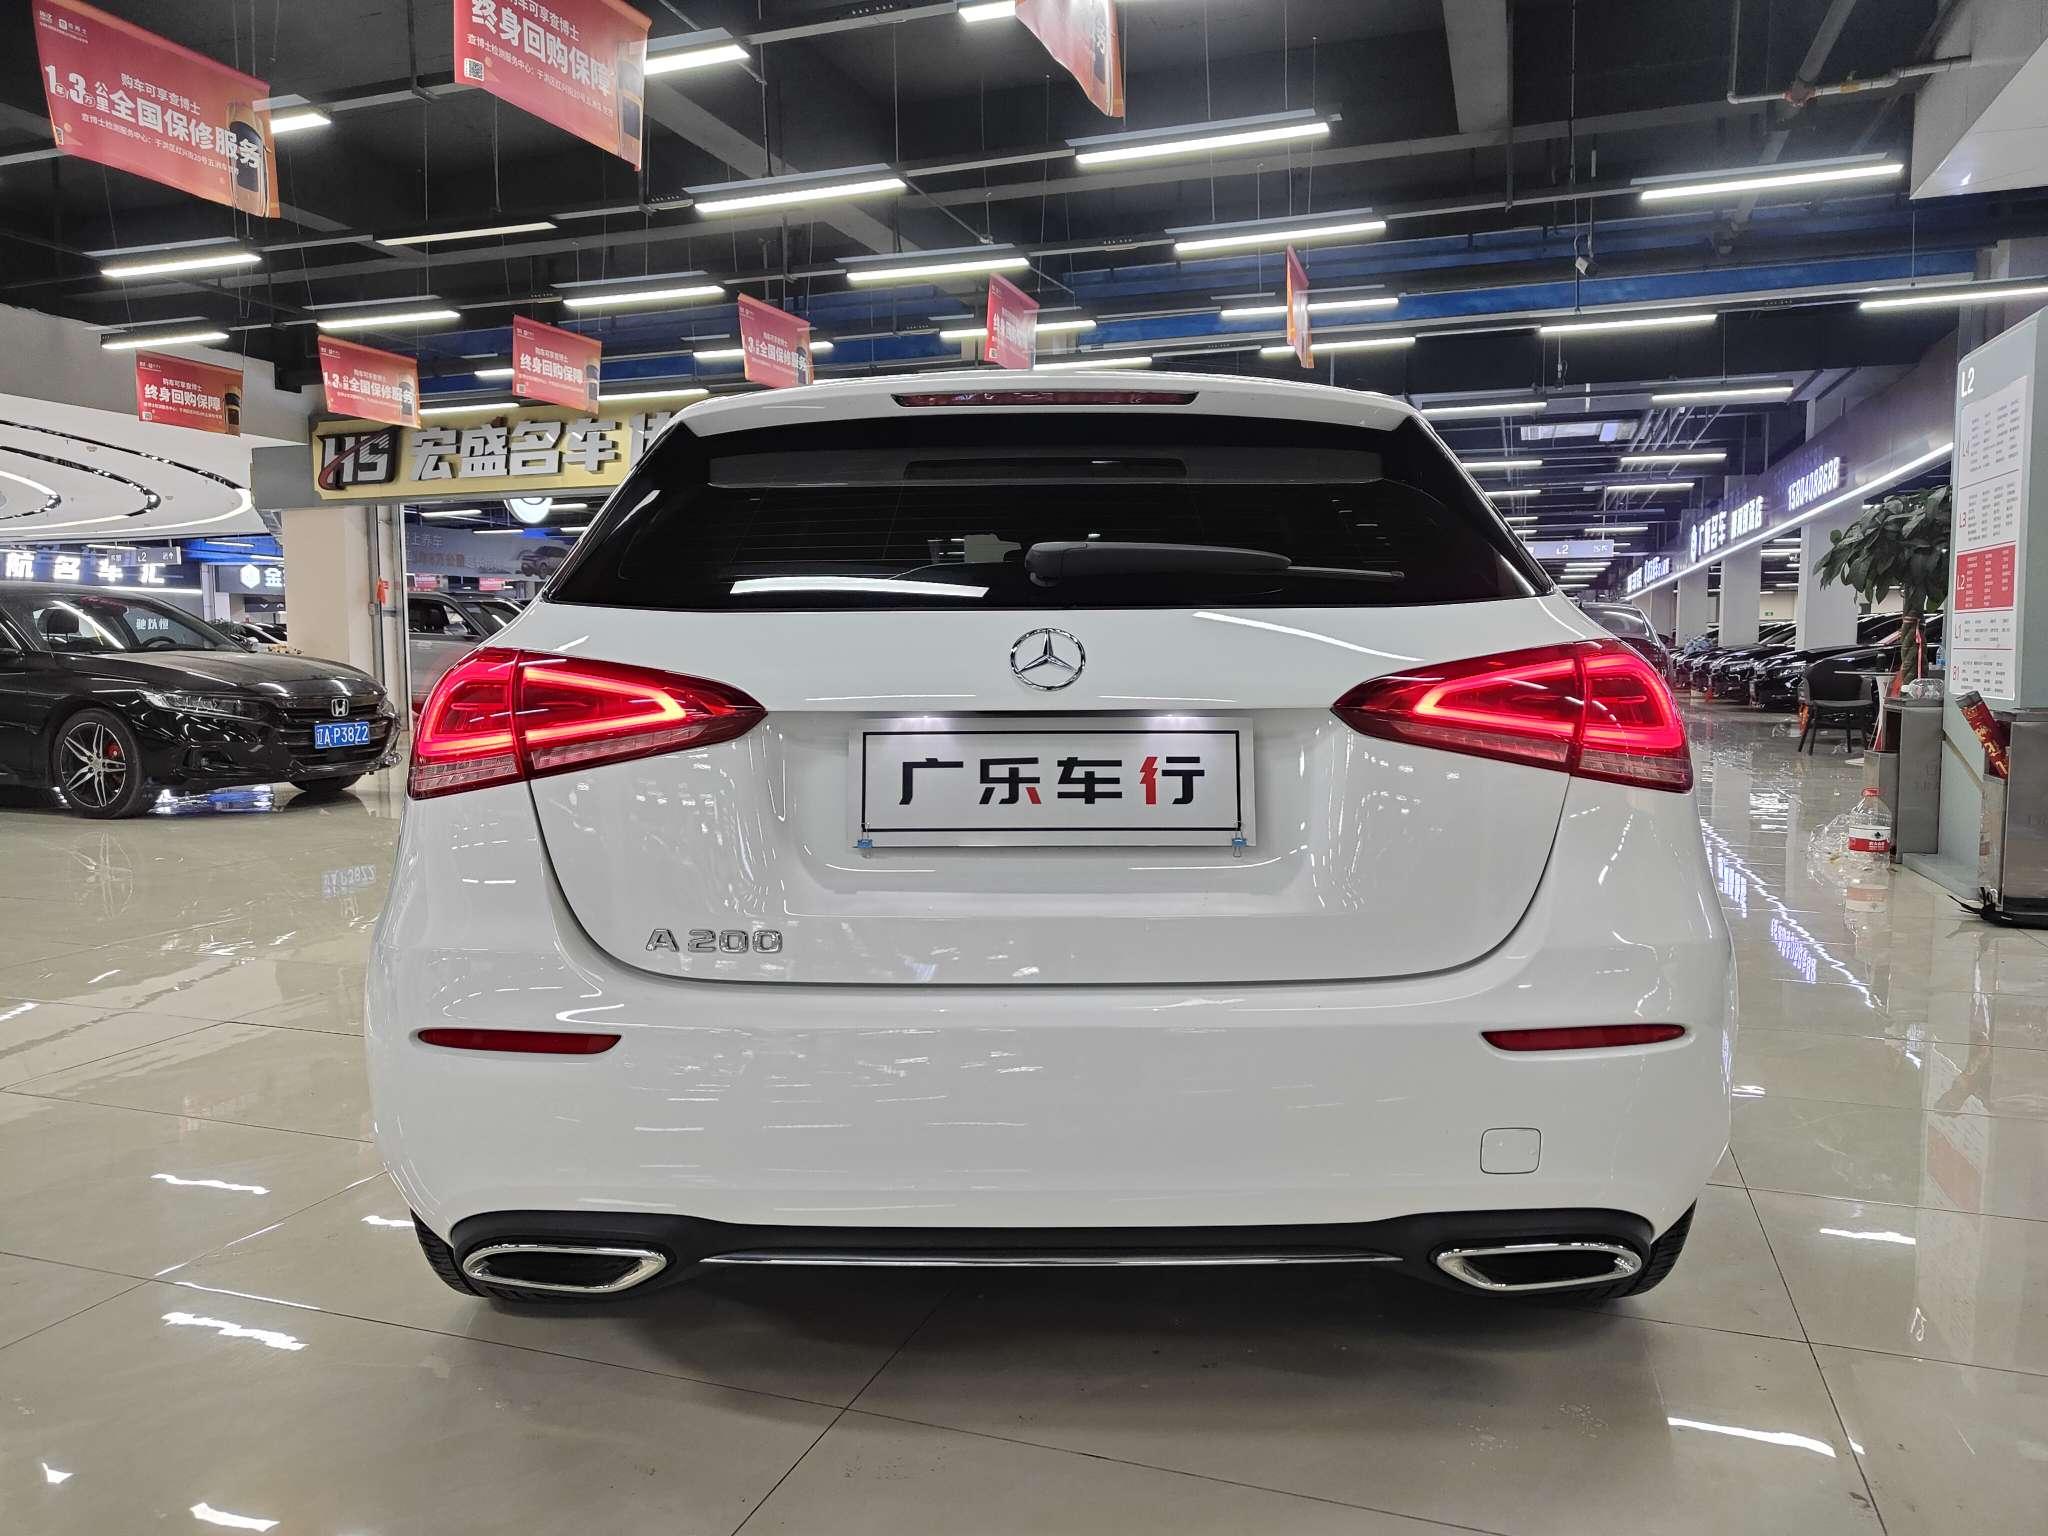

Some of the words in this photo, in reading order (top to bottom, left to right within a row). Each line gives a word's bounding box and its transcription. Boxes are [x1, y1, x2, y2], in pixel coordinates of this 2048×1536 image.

[511, 0, 580, 41] 车可享查博士
[471, 0, 610, 97] 终身回购保障
[120, 72, 201, 115] 购车可享查博士
[144, 383, 222, 411] 终身回购保障
[1961, 367, 1975, 397] L2
[1959, 511, 1967, 529] L3
[1957, 574, 1965, 591] L2
[899, 756, 1205, 805] 广乐车行
[645, 928, 680, 952] A
[687, 929, 784, 953] 200
